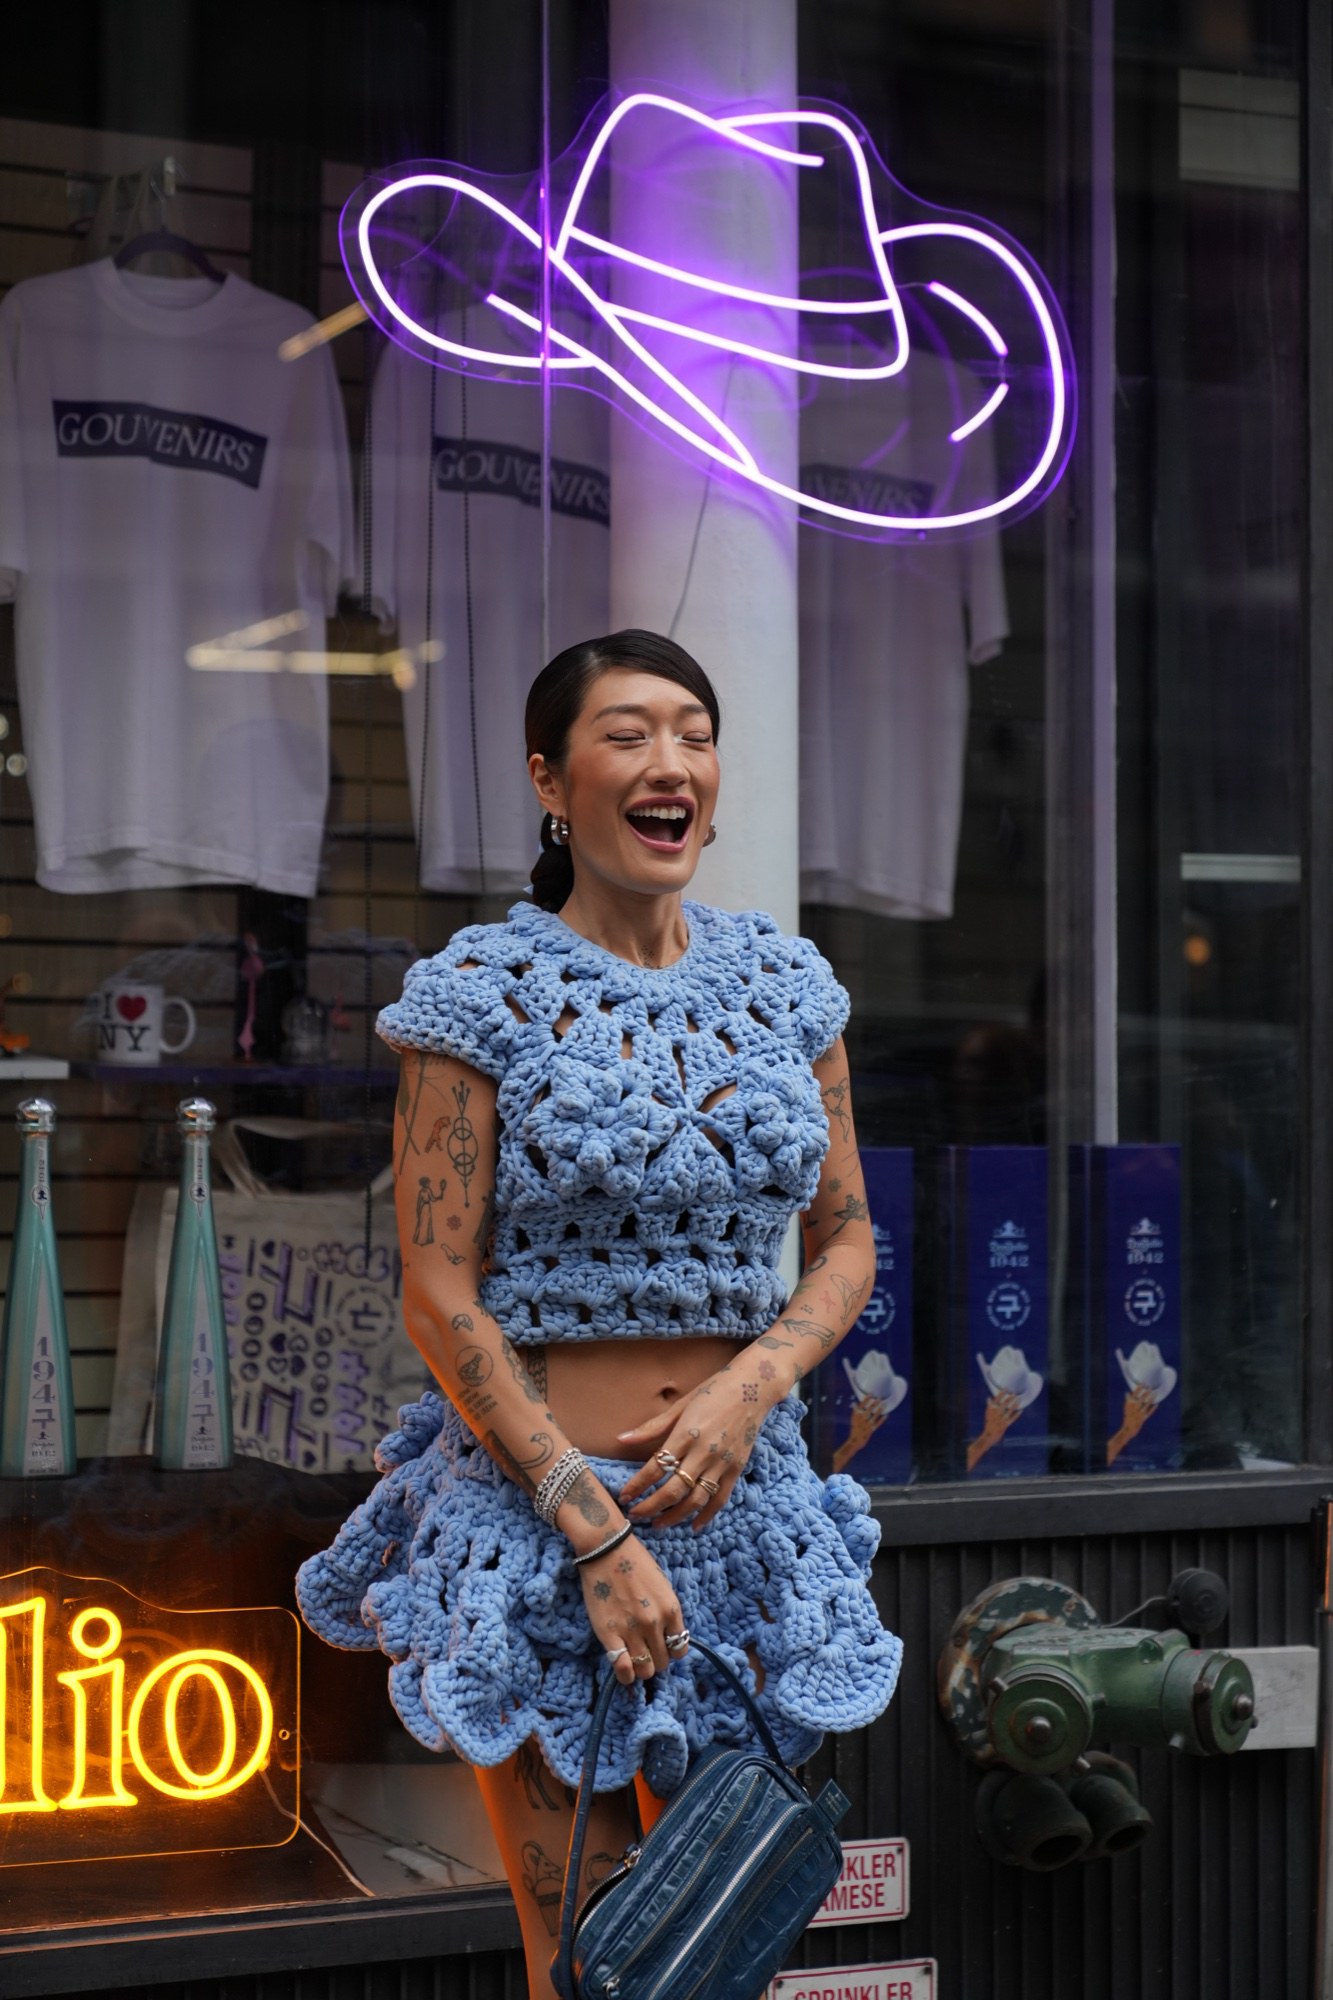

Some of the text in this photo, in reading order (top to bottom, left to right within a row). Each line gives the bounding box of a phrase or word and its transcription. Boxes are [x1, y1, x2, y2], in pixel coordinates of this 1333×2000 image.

[58, 412, 255, 472] GOUVENIRS
[99, 1023, 151, 1052] NY
[839, 1853, 896, 1881] KLER
